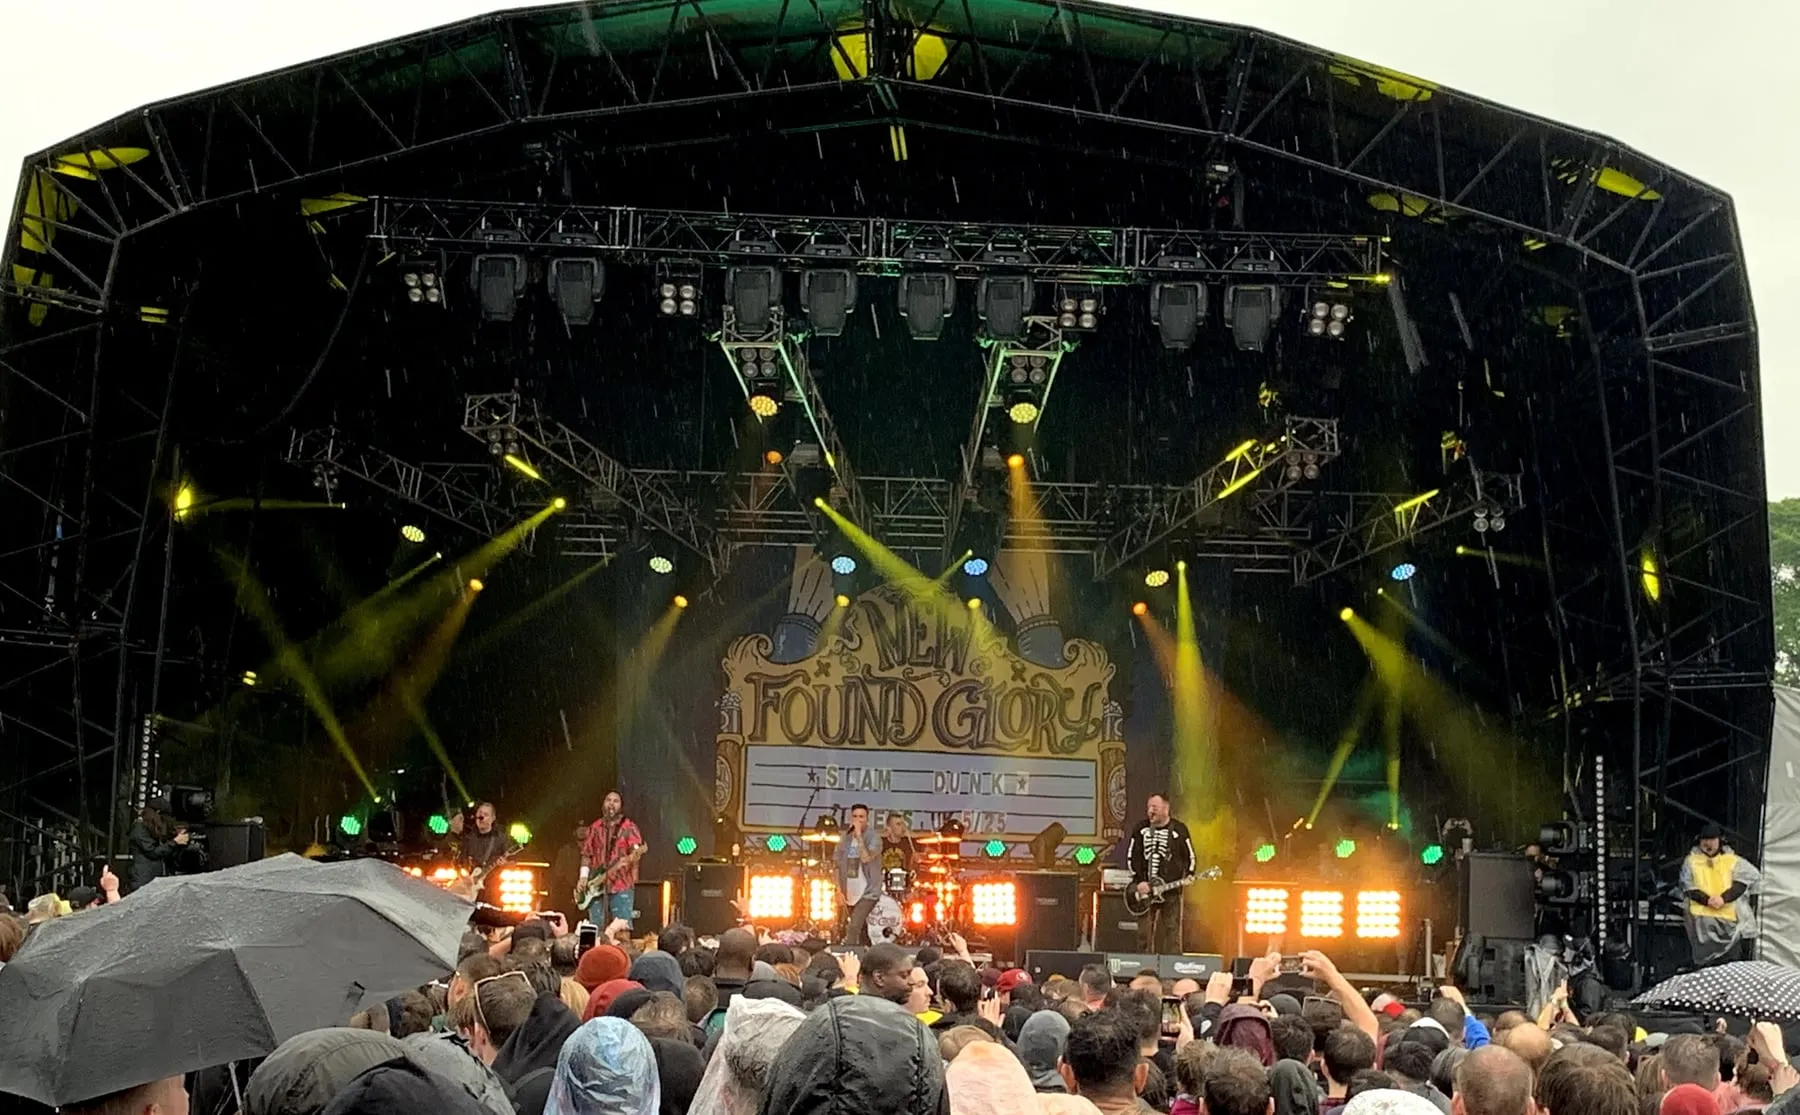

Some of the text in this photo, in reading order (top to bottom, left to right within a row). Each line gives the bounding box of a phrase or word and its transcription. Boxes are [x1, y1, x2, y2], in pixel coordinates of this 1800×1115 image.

[858, 597, 975, 676] NEW
[744, 672, 1103, 755] FOUND GLORY
[826, 766, 1003, 796] SLAM DUNK
[962, 811, 1007, 834] 5/25
